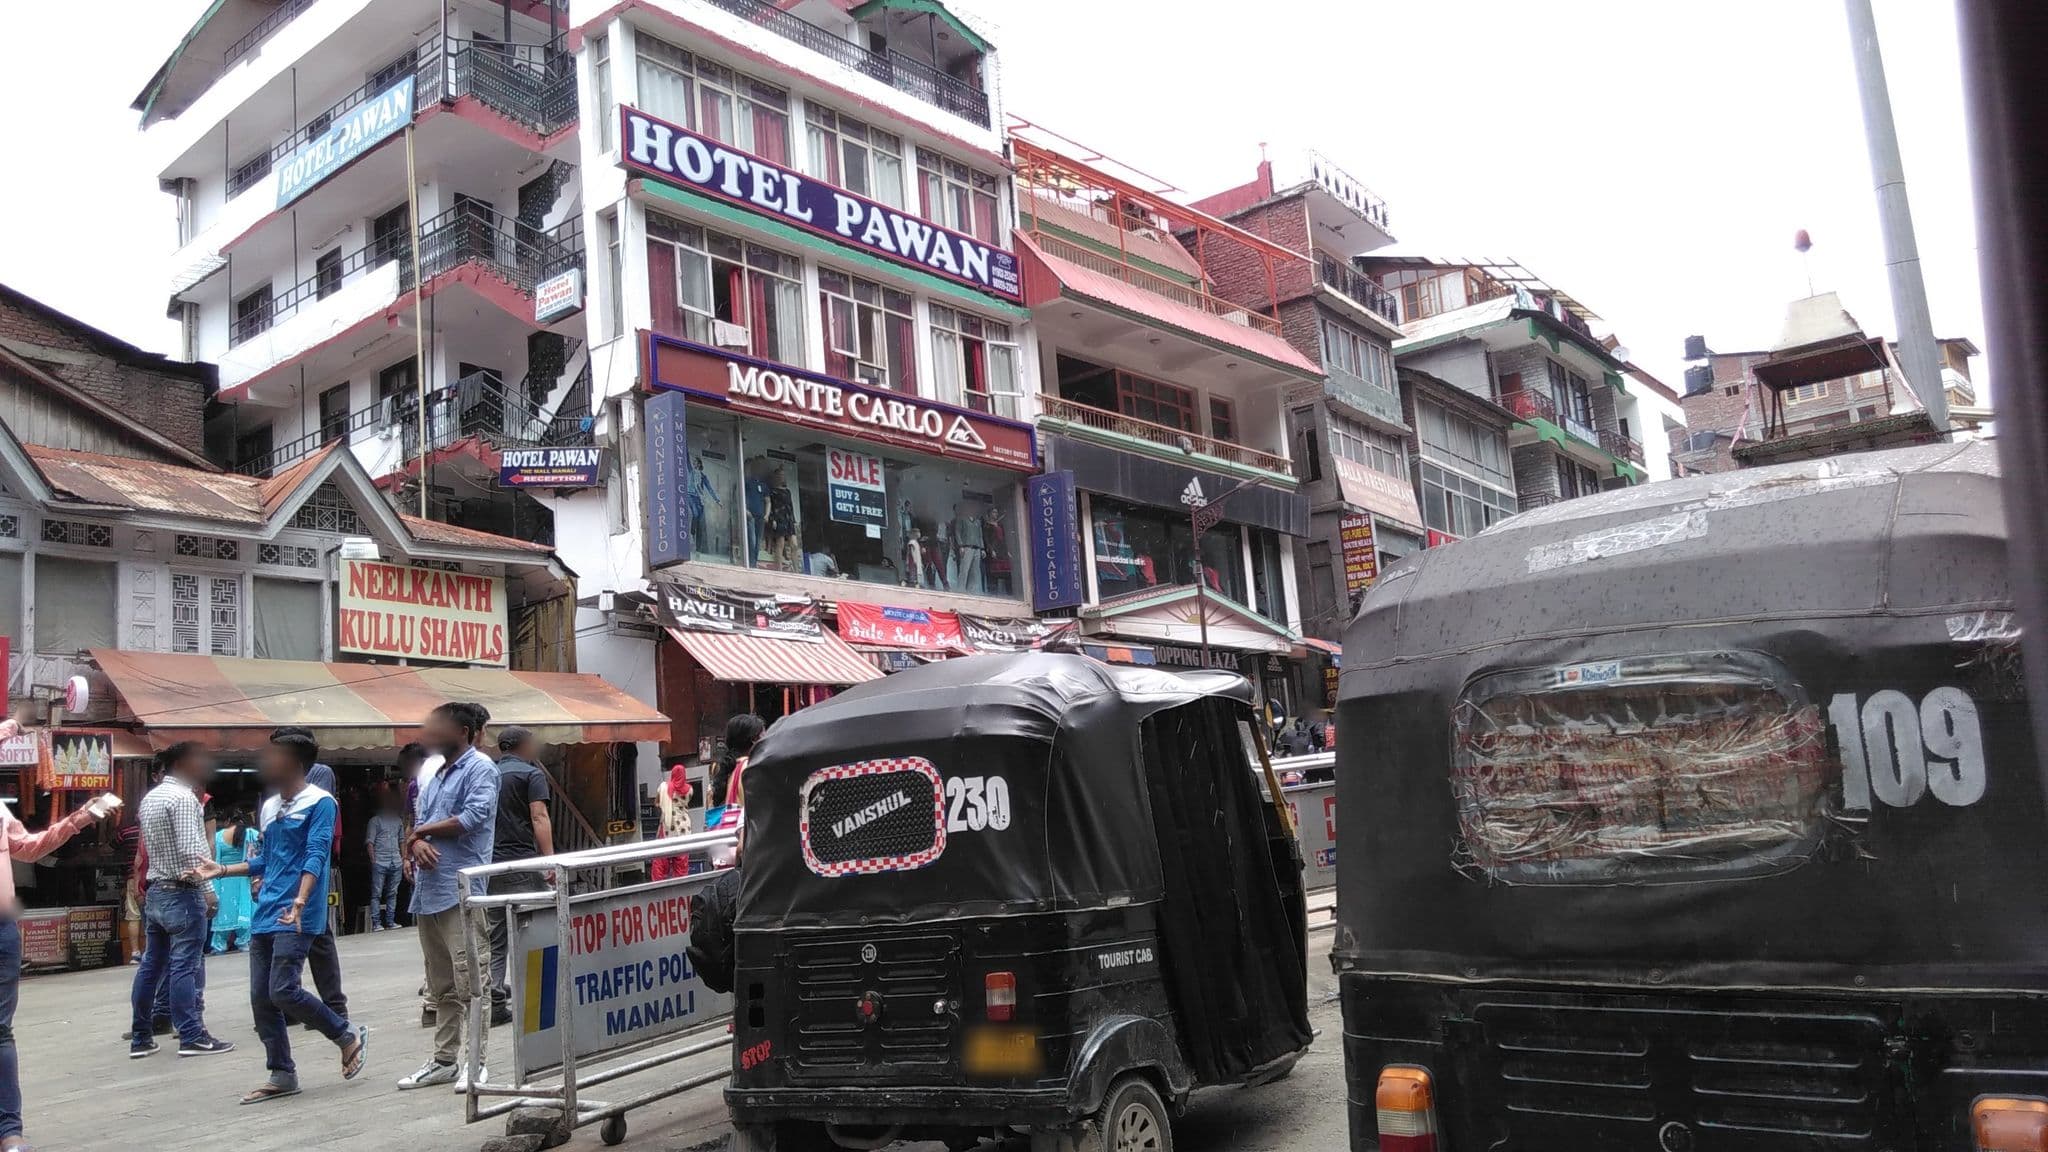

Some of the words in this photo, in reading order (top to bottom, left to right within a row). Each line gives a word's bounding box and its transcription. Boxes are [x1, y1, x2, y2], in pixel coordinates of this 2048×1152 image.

[281, 134, 335, 196] HOTEL
[338, 84, 409, 155] PAWAN
[630, 116, 813, 223] HOTEL
[834, 193, 990, 285] PAWAN
[539, 287, 572, 307] Pawan
[544, 279, 569, 295] Hotel
[727, 362, 844, 417] MONTE
[848, 393, 943, 437] CARLO
[503, 451, 546, 467] HOTEL
[549, 449, 600, 467] PAWAN
[655, 422, 666, 485] MONTE
[675, 421, 685, 477] MONTE
[831, 451, 881, 486] SALE
[678, 484, 687, 540] CARLO
[835, 489, 853, 500] BUY
[854, 492, 861, 501] 2
[836, 502, 855, 513] GET
[856, 506, 861, 514] 1
[862, 506, 884, 517] FREE
[1067, 494, 1076, 540] MONTE
[657, 490, 669, 552] CARLO
[1042, 496, 1055, 547] MONTE
[1341, 514, 1369, 529] Balaji
[349, 560, 493, 613] NEELKANTH
[1046, 550, 1059, 600] CARLO
[1071, 545, 1080, 590] CARLO
[668, 596, 736, 620] HAVELI
[340, 608, 416, 655] KULLU
[420, 616, 503, 663] SHAWLS
[849, 620, 884, 641] Sale
[894, 627, 927, 646] Sale
[967, 626, 1017, 643] HAVELI
[0, 748, 35, 762] SOFTY
[1827, 686, 1986, 811] 109
[63, 775, 73, 787] IN
[74, 776, 79, 786] 1
[81, 775, 110, 788] SOFTY
[946, 775, 1011, 833] 230
[831, 790, 912, 839] VANSHUL
[70, 922, 88, 931] FOUR
[89, 921, 97, 930] IN
[97, 920, 112, 929] ONE
[70, 931, 87, 940] FIVE
[88, 930, 97, 939] IN
[97, 930, 112, 938] ONE
[570, 912, 607, 956] TOP
[612, 906, 644, 948] FOR
[1098, 949, 1135, 970] TOURIST
[1135, 947, 1154, 964] CAB
[575, 960, 654, 1006] TRAFFIC
[607, 990, 695, 1036] MANALI
[742, 1039, 771, 1071] STOP
